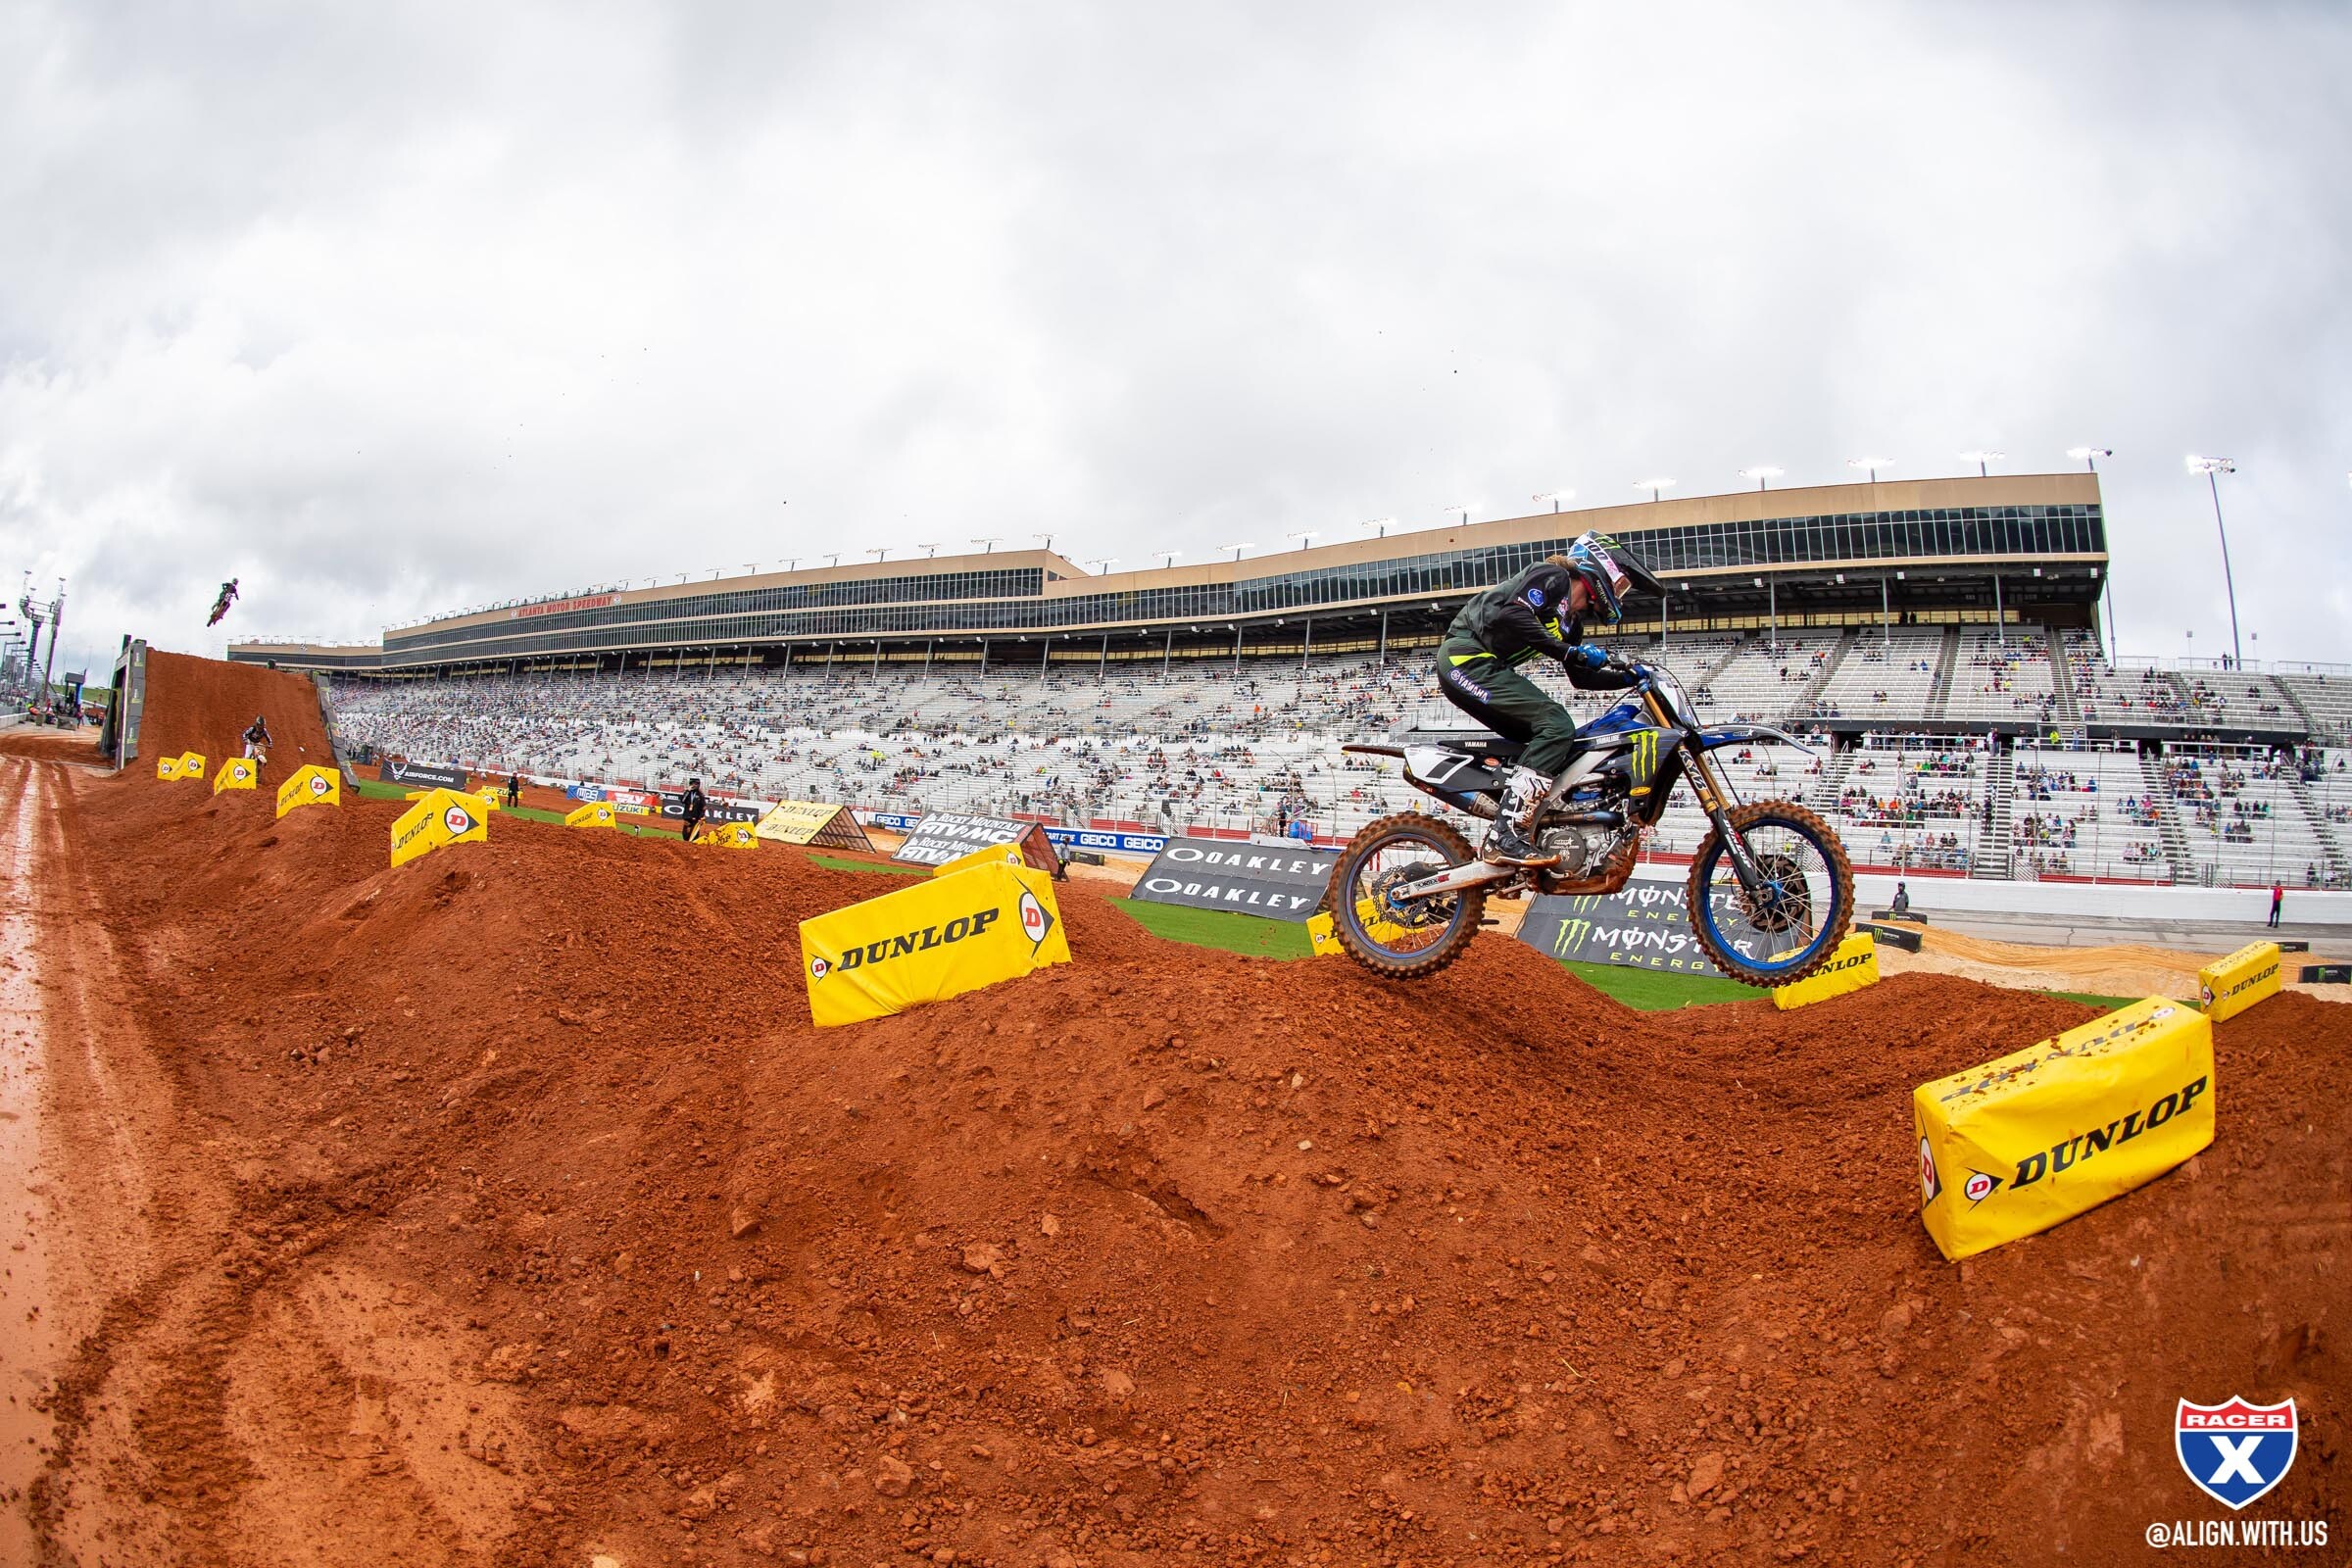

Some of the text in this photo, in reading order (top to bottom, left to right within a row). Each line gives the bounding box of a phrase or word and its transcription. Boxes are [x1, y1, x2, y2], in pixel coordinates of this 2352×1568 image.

[518, 596, 612, 617] ATLANTA MOTOR SPEEDWAY
[1457, 675, 1489, 701] YAMAHA
[404, 771, 455, 784] AIRFORCE.COM
[280, 781, 304, 807] DUNLOP
[612, 804, 644, 813] UZUKI
[705, 809, 758, 821] AKLEY
[784, 806, 835, 817] DUNLOP
[397, 812, 434, 850] DUNLOP
[766, 824, 814, 836] DUNLOP
[876, 815, 901, 826] GEICO
[938, 812, 1027, 832] ROCKY MOUNTAIN
[919, 837, 949, 849] ROCKY
[1080, 833, 1117, 848] GEICO
[1123, 836, 1164, 851] GEICO
[1204, 851, 1331, 876] OAKLEY
[1182, 882, 1311, 910] OAKLEY
[837, 907, 1000, 971] DUNLOP
[1609, 952, 1722, 973] ENERG
[1807, 953, 1873, 978] UNLOP
[2231, 963, 2279, 997] DUNLOP
[2009, 1075, 2208, 1191] DUNLOP
